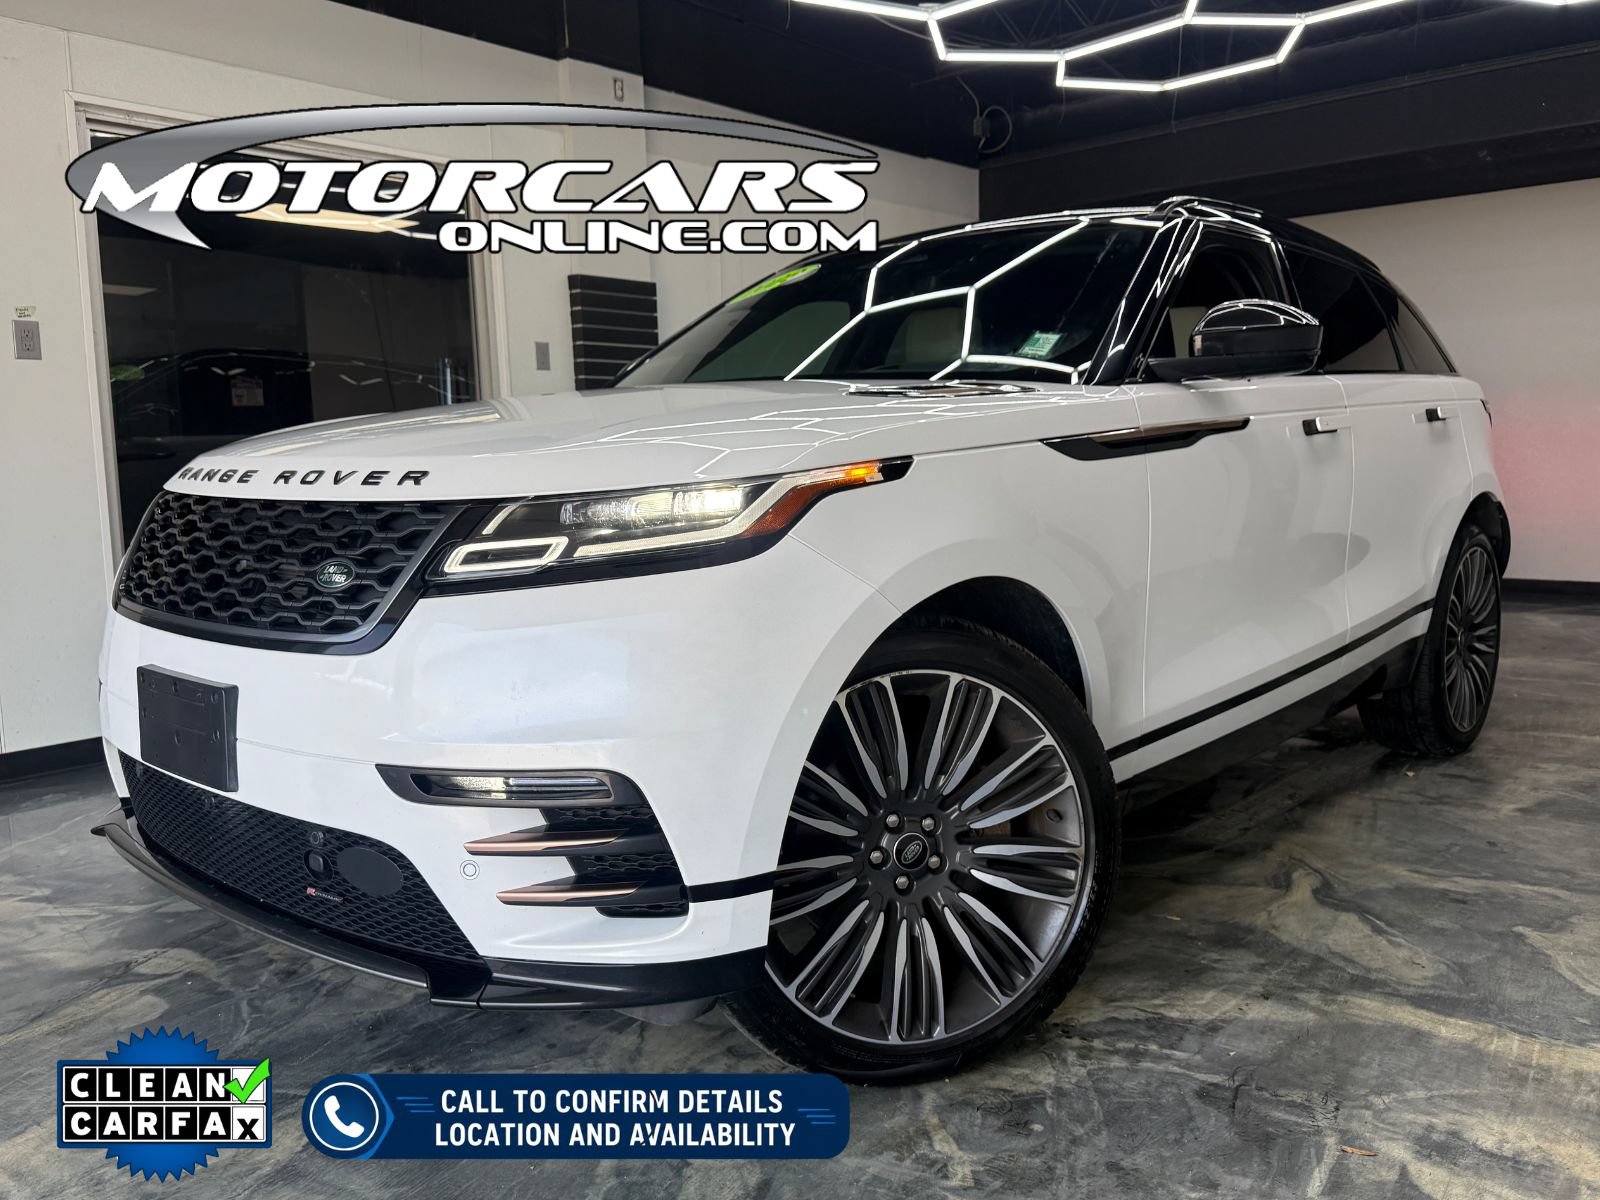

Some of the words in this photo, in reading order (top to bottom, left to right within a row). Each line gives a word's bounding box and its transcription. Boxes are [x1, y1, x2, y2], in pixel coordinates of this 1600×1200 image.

[178, 467, 259, 484] RANGE
[273, 470, 430, 486] ROVER
[323, 565, 344, 574] LAND
[321, 573, 347, 582] ROVER
